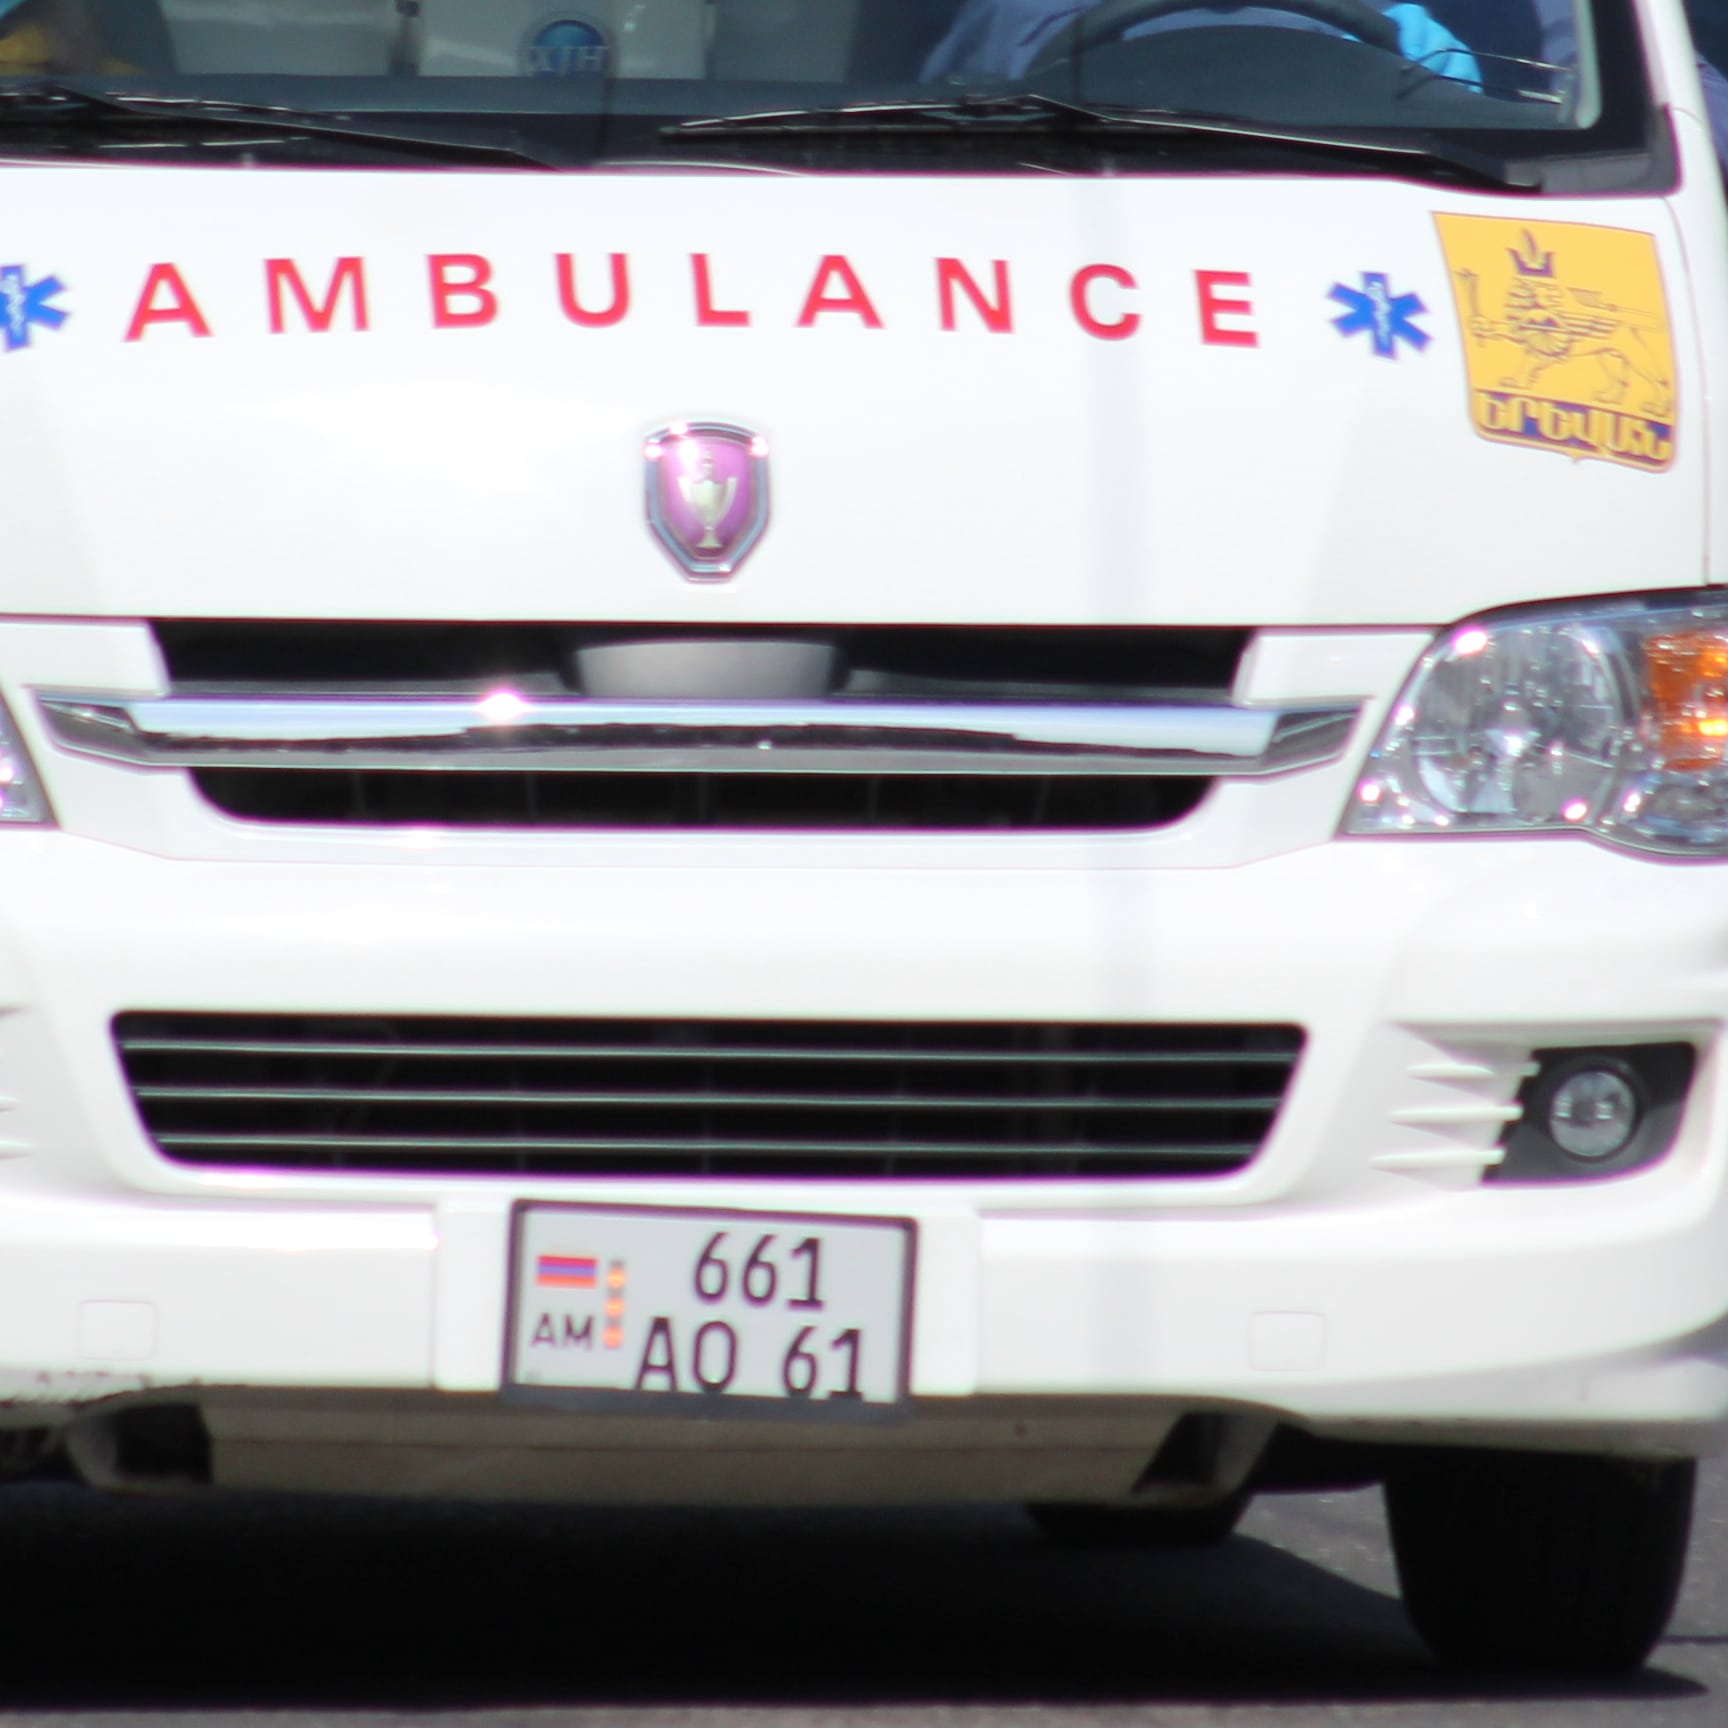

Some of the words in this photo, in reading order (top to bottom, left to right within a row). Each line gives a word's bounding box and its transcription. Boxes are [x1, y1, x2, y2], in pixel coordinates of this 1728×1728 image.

[125, 252, 1259, 348] AMBULANCE
[693, 1231, 825, 1311] 661
[530, 1312, 596, 1350] AM
[634, 1316, 739, 1396] AO
[782, 1325, 864, 1401] 61
